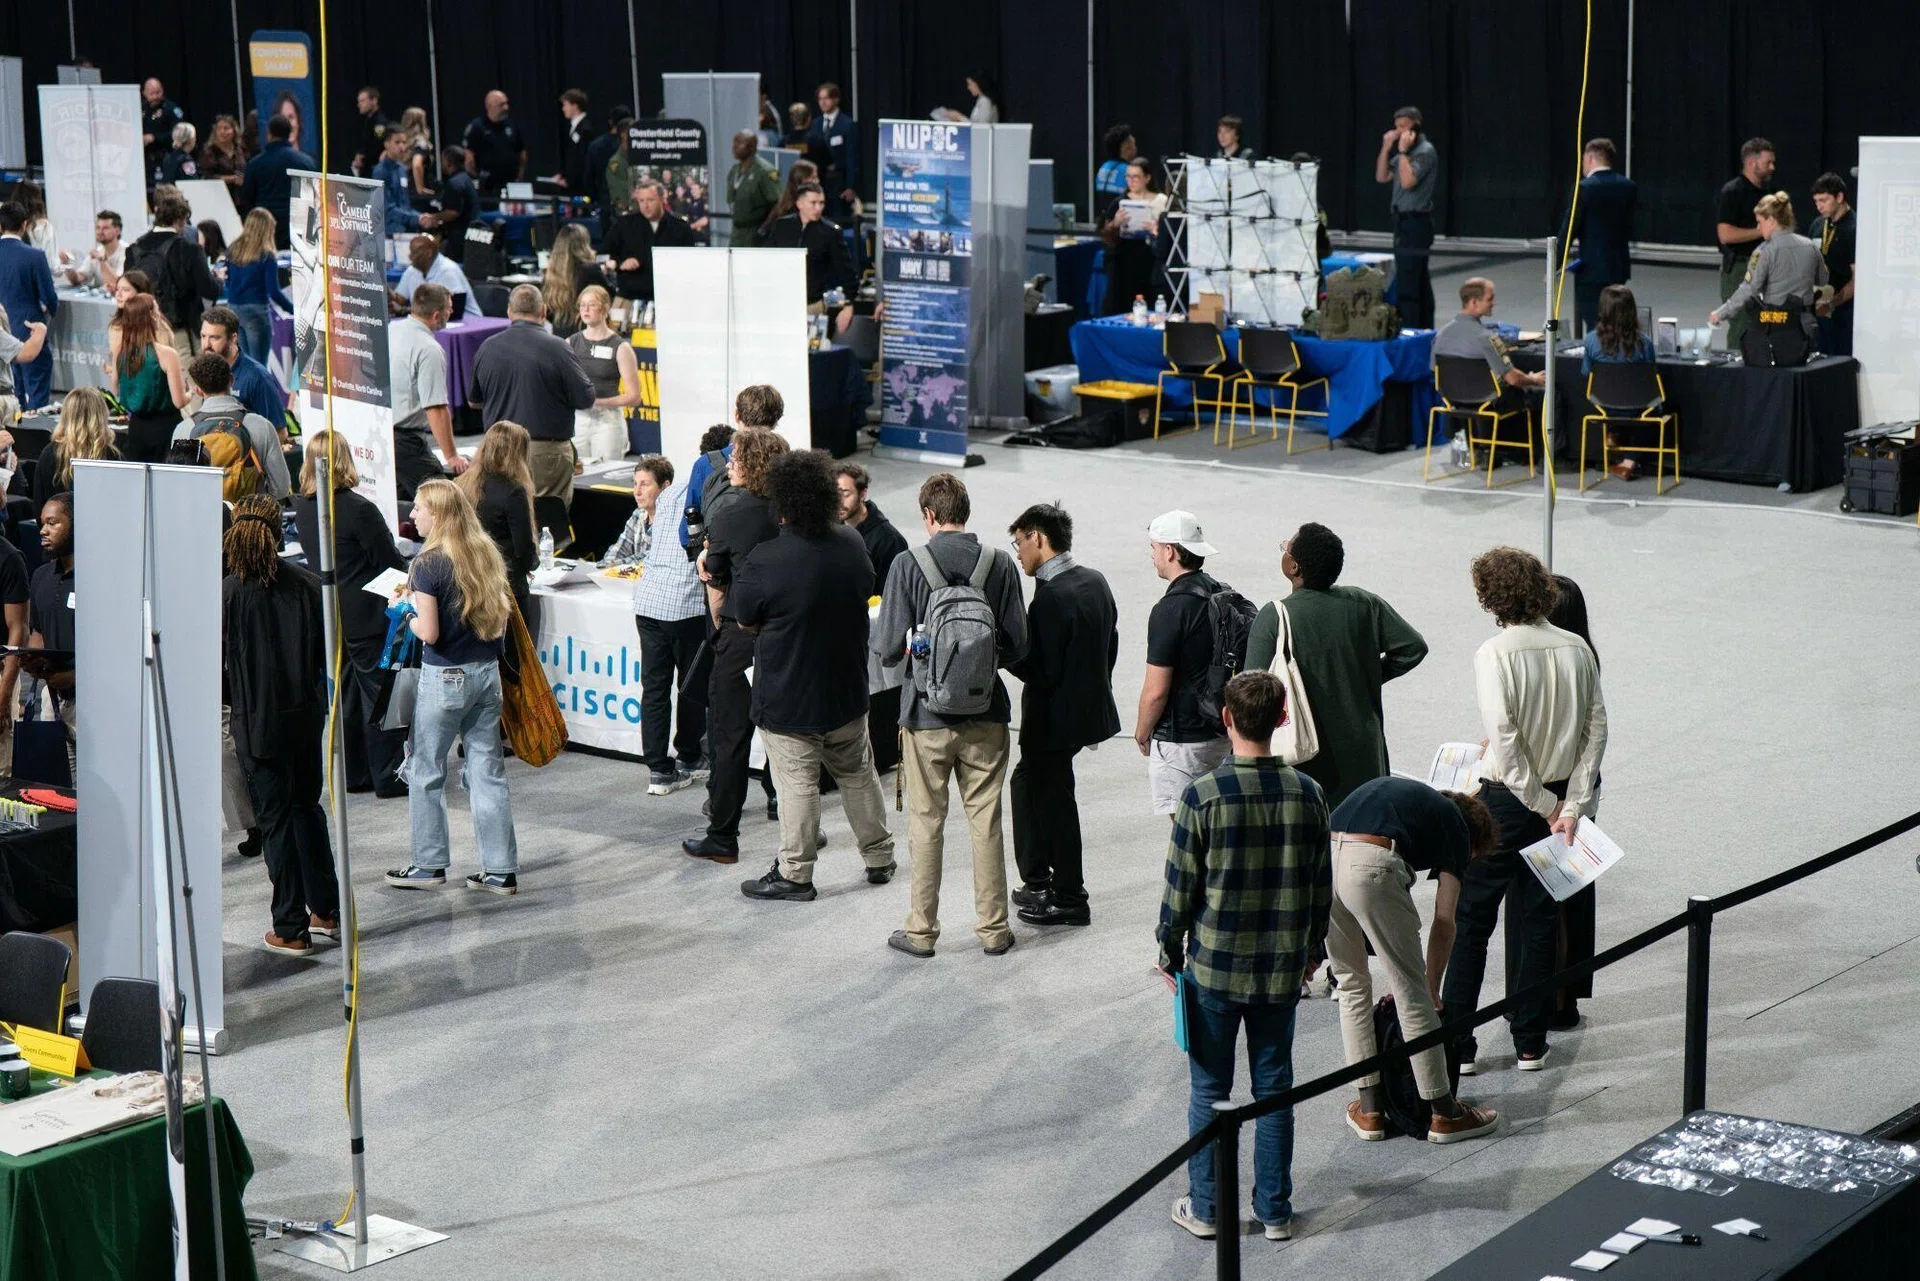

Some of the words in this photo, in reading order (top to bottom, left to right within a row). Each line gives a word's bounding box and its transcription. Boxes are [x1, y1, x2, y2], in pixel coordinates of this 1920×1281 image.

[629, 128, 674, 138] Chesterfield
[675, 128, 701, 139] County
[892, 123, 958, 151] NUPOC
[632, 140, 655, 149] Police
[656, 140, 699, 150] Department
[340, 201, 372, 219] CAMELOT
[340, 218, 374, 234] SOFTWARE
[328, 255, 340, 268] OIN
[341, 257, 355, 270] OUR
[355, 258, 374, 273] TEAM
[332, 276, 361, 289] Implementation
[1760, 311, 1788, 323] SHERIFF
[638, 407, 659, 421] THE
[354, 447, 364, 458] WE
[365, 449, 375, 460] DO
[553, 683, 641, 724] CISCO
[38, 1049, 67, 1061] Communities
